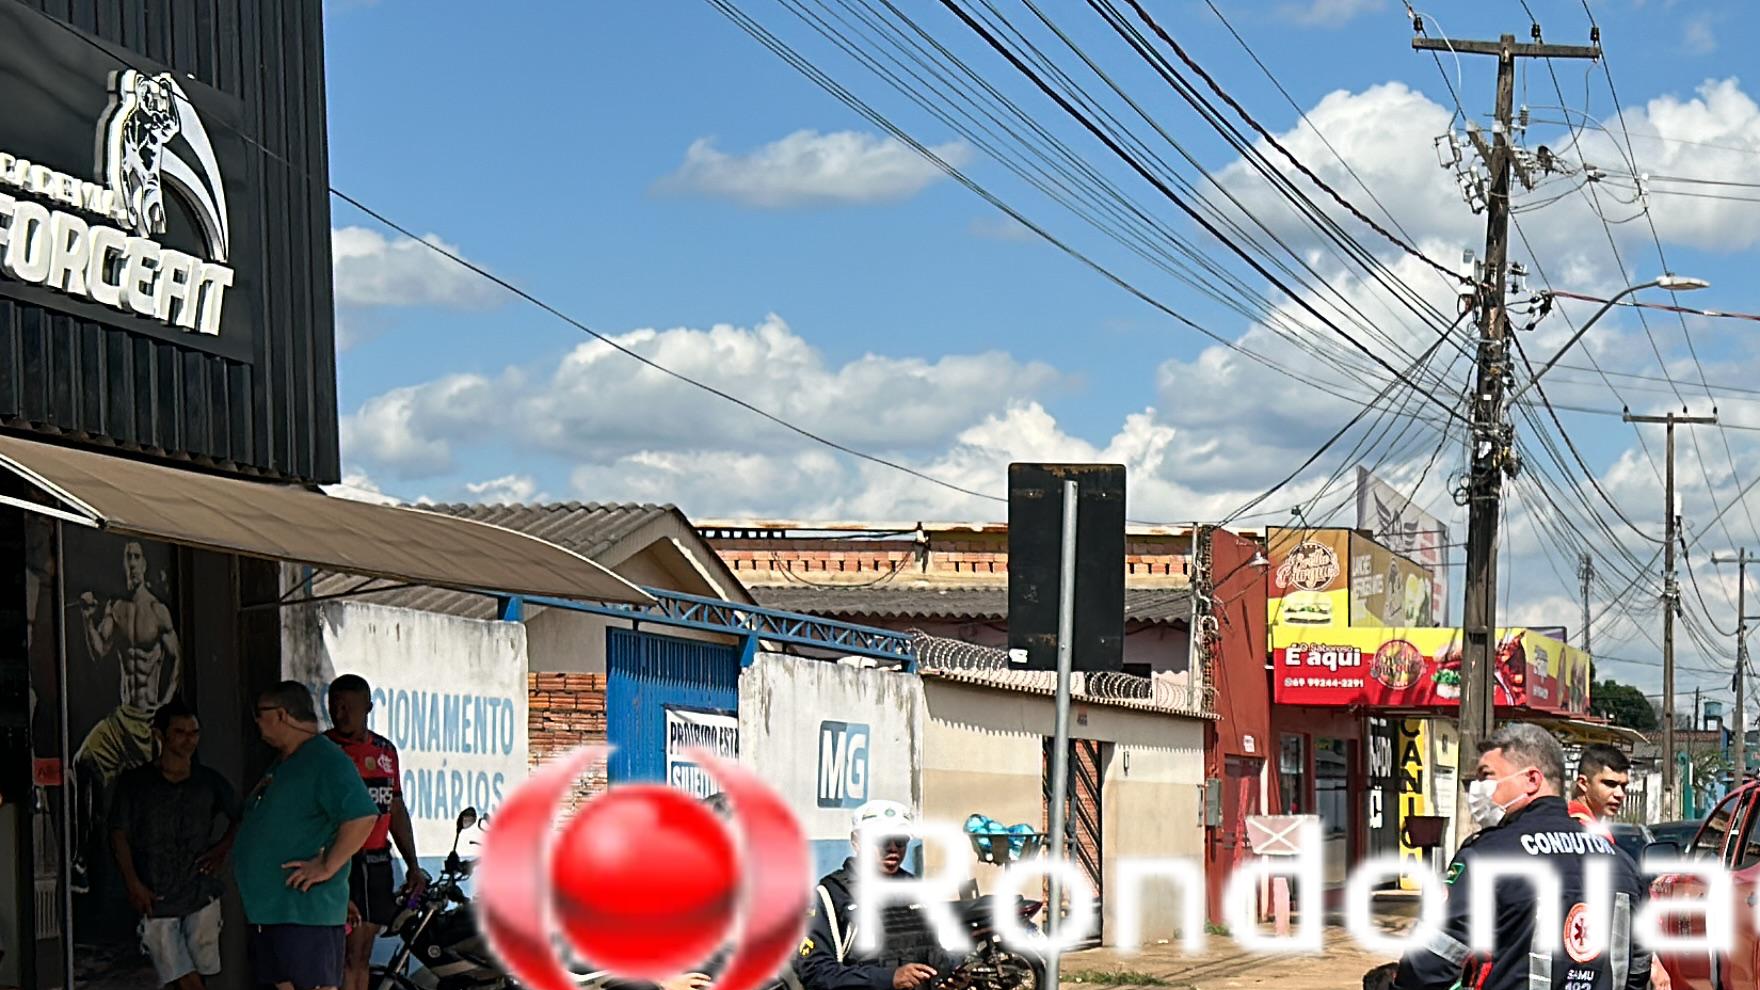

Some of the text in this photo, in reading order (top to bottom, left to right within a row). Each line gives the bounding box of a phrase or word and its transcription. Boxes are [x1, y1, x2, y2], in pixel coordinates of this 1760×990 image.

[1285, 643, 1301, 666] É
[1306, 648, 1361, 672] aqui
[304, 682, 514, 756] CIONAMENTO
[820, 730, 866, 799] MG
[402, 758, 505, 820] ONÁRIOS
[1520, 831, 1616, 856] CONDUTOR
[1567, 970, 1595, 981] SAMU
